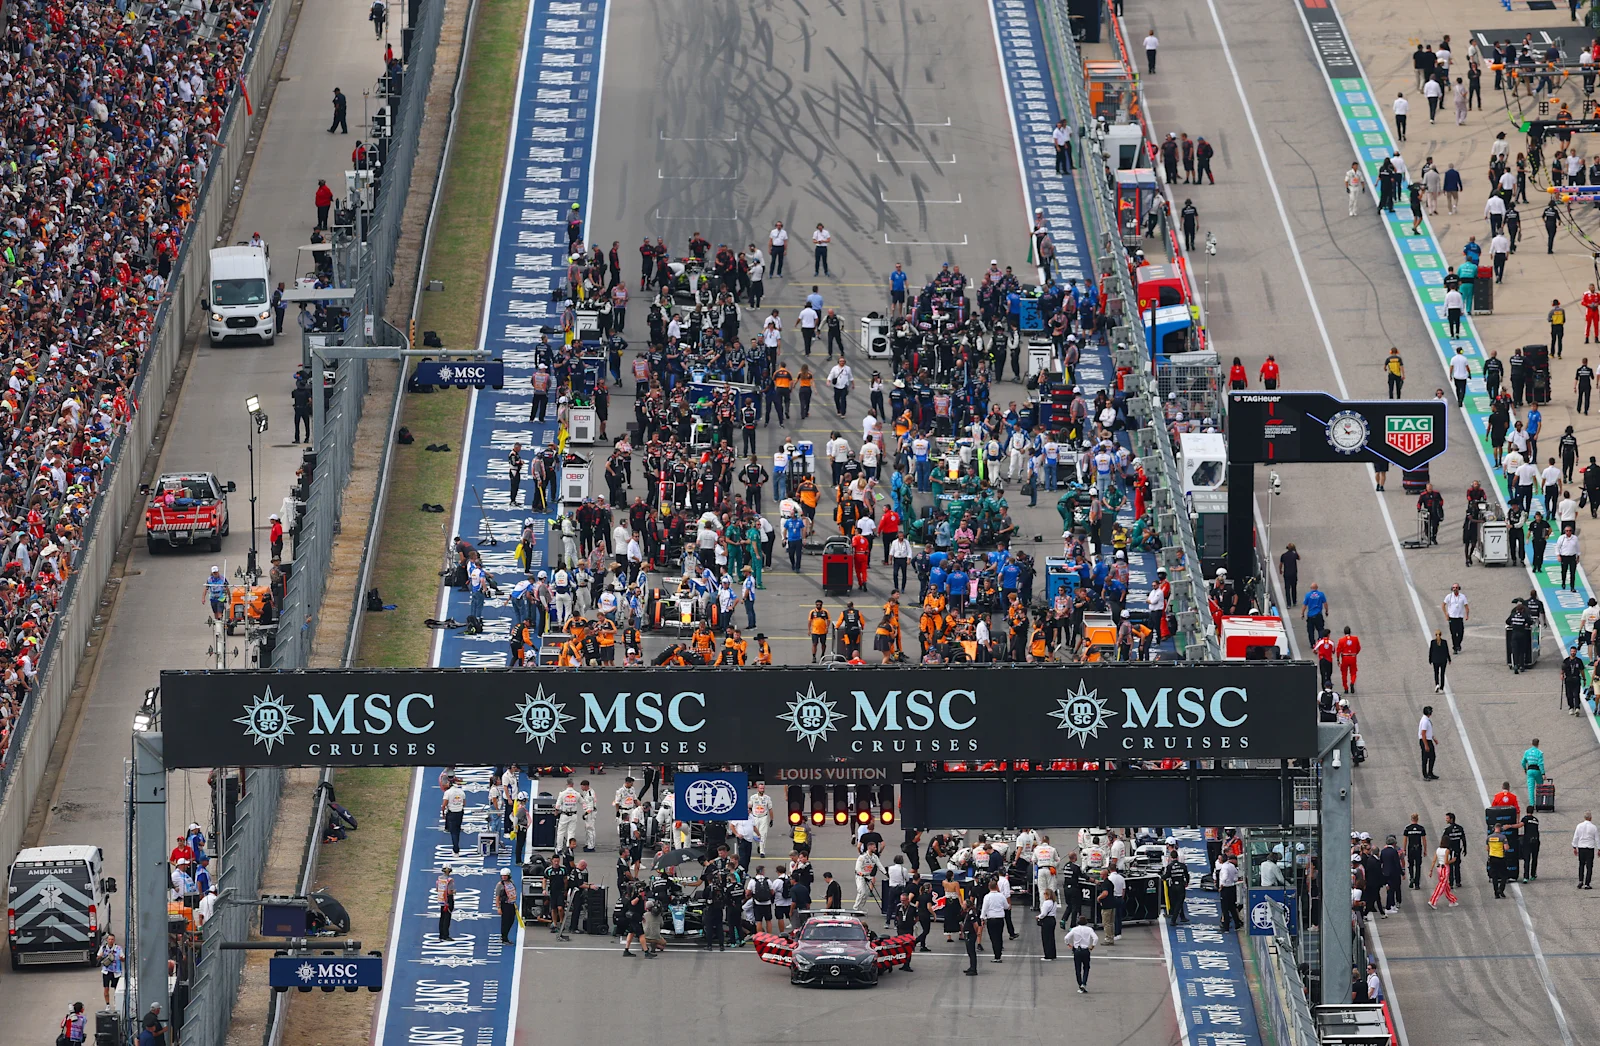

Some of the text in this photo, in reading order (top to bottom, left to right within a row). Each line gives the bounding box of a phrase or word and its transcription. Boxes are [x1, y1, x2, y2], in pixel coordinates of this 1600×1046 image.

[455, 367, 485, 378] MSC
[1390, 418, 1429, 430] TAG
[1388, 432, 1431, 452] HEUER
[1490, 535, 1502, 544] 77
[308, 693, 434, 734] MSC
[580, 692, 706, 732] MSC
[851, 690, 976, 730] MSC
[1122, 688, 1248, 728] MSC
[309, 744, 435, 755] CRUISES
[581, 742, 706, 753] CRUISES
[852, 740, 977, 752] CRUISES
[1123, 738, 1248, 749] CRUISES
[781, 768, 886, 780] LOUIS VUITTON
[28, 868, 73, 876] AMBULANCE
[1082, 888, 1090, 899] 12
[421, 933, 476, 955] MSC
[884, 953, 906, 961] AMG
[318, 964, 358, 977] MSC
[415, 979, 471, 1002] MSC
